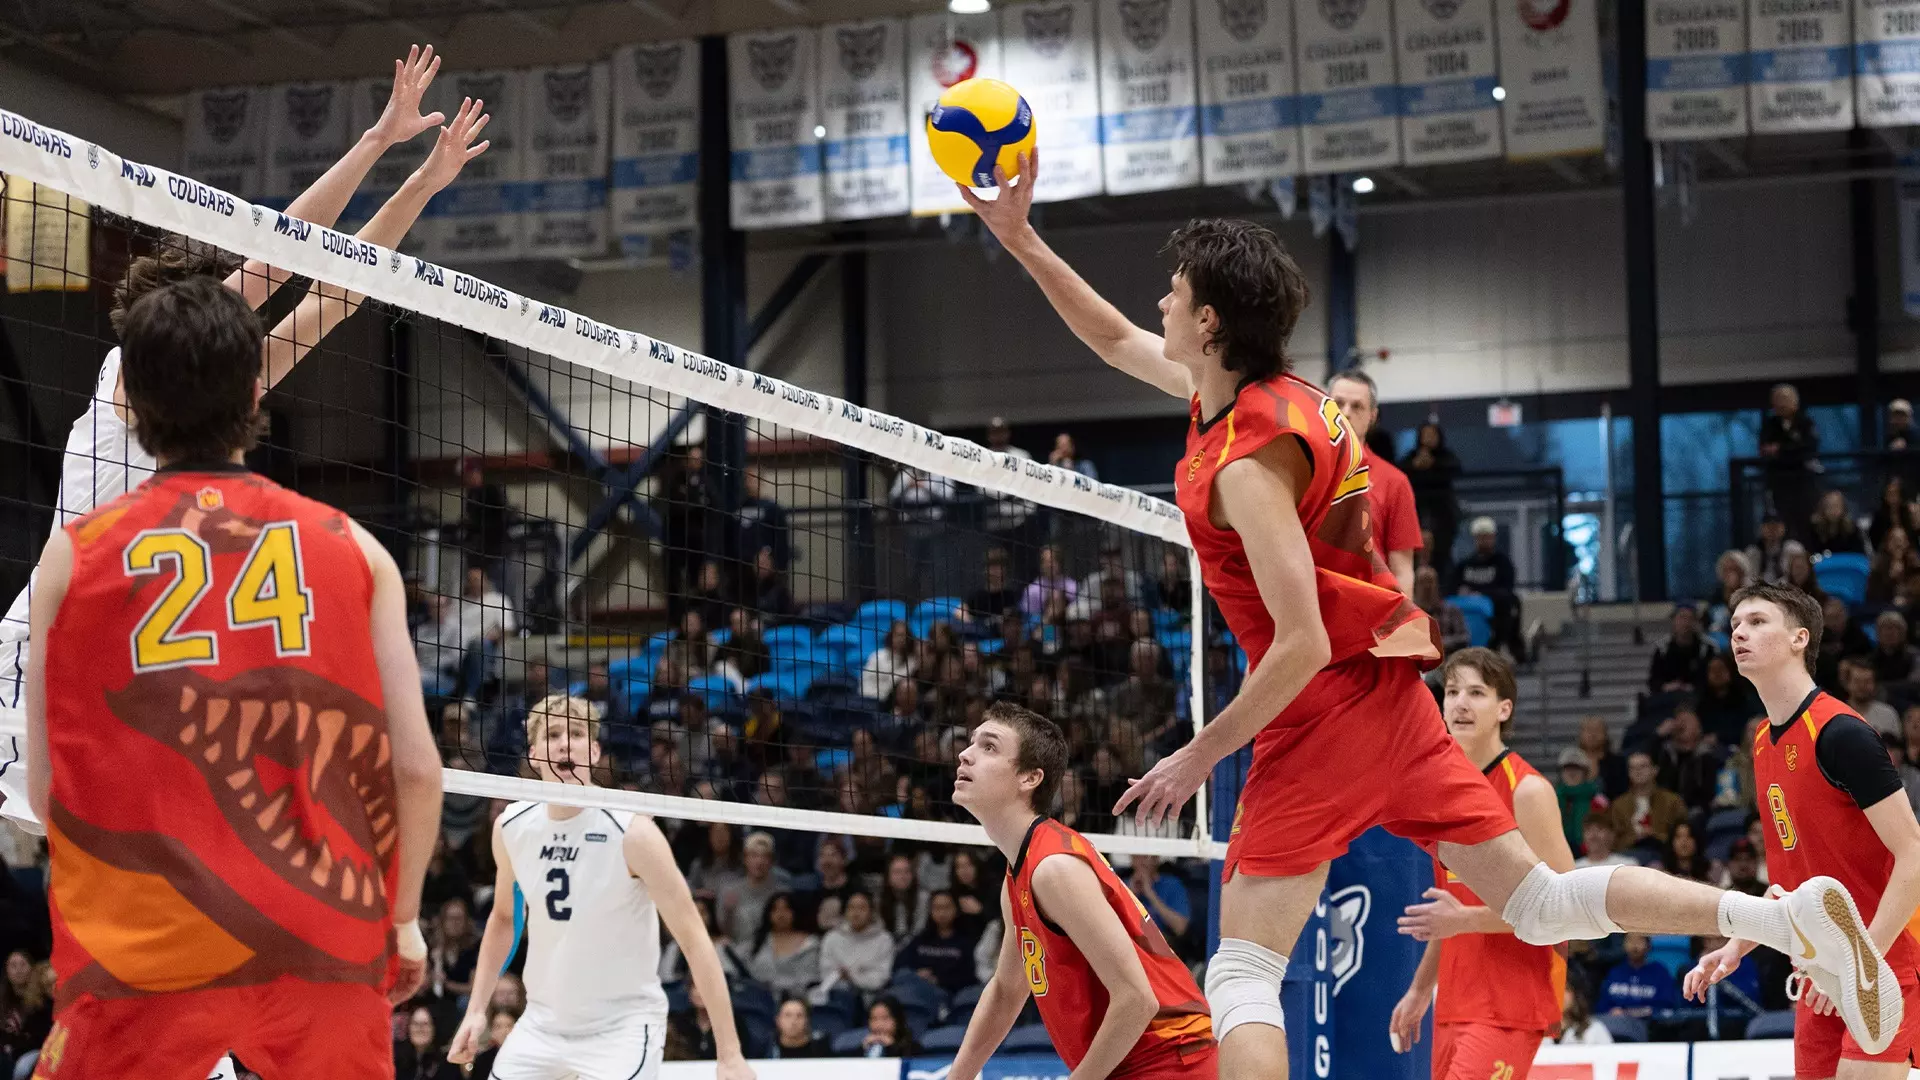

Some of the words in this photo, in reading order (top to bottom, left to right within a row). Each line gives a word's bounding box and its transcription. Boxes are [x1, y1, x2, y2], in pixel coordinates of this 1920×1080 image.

[1, 113, 72, 159] COUGARS
[121, 158, 156, 188] MRU
[168, 176, 235, 217] COUGARS
[274, 212, 311, 242] MRU
[321, 230, 378, 266] COUGARS
[414, 259, 444, 286] MRU
[454, 274, 508, 309] COUGARS
[539, 305, 567, 328] MRU
[575, 317, 621, 349] COUGARS
[649, 340, 674, 364] MRU
[683, 352, 727, 381] COUGARS
[753, 373, 775, 394] MRU
[781, 384, 820, 410] COUGARS
[841, 402, 863, 423] MRU
[869, 412, 904, 437] COUGARS
[951, 441, 981, 462] COUGARS
[123, 520, 314, 674] 24
[1767, 783, 1798, 850] 8
[539, 845, 579, 862] MRU
[546, 868, 572, 921] 2
